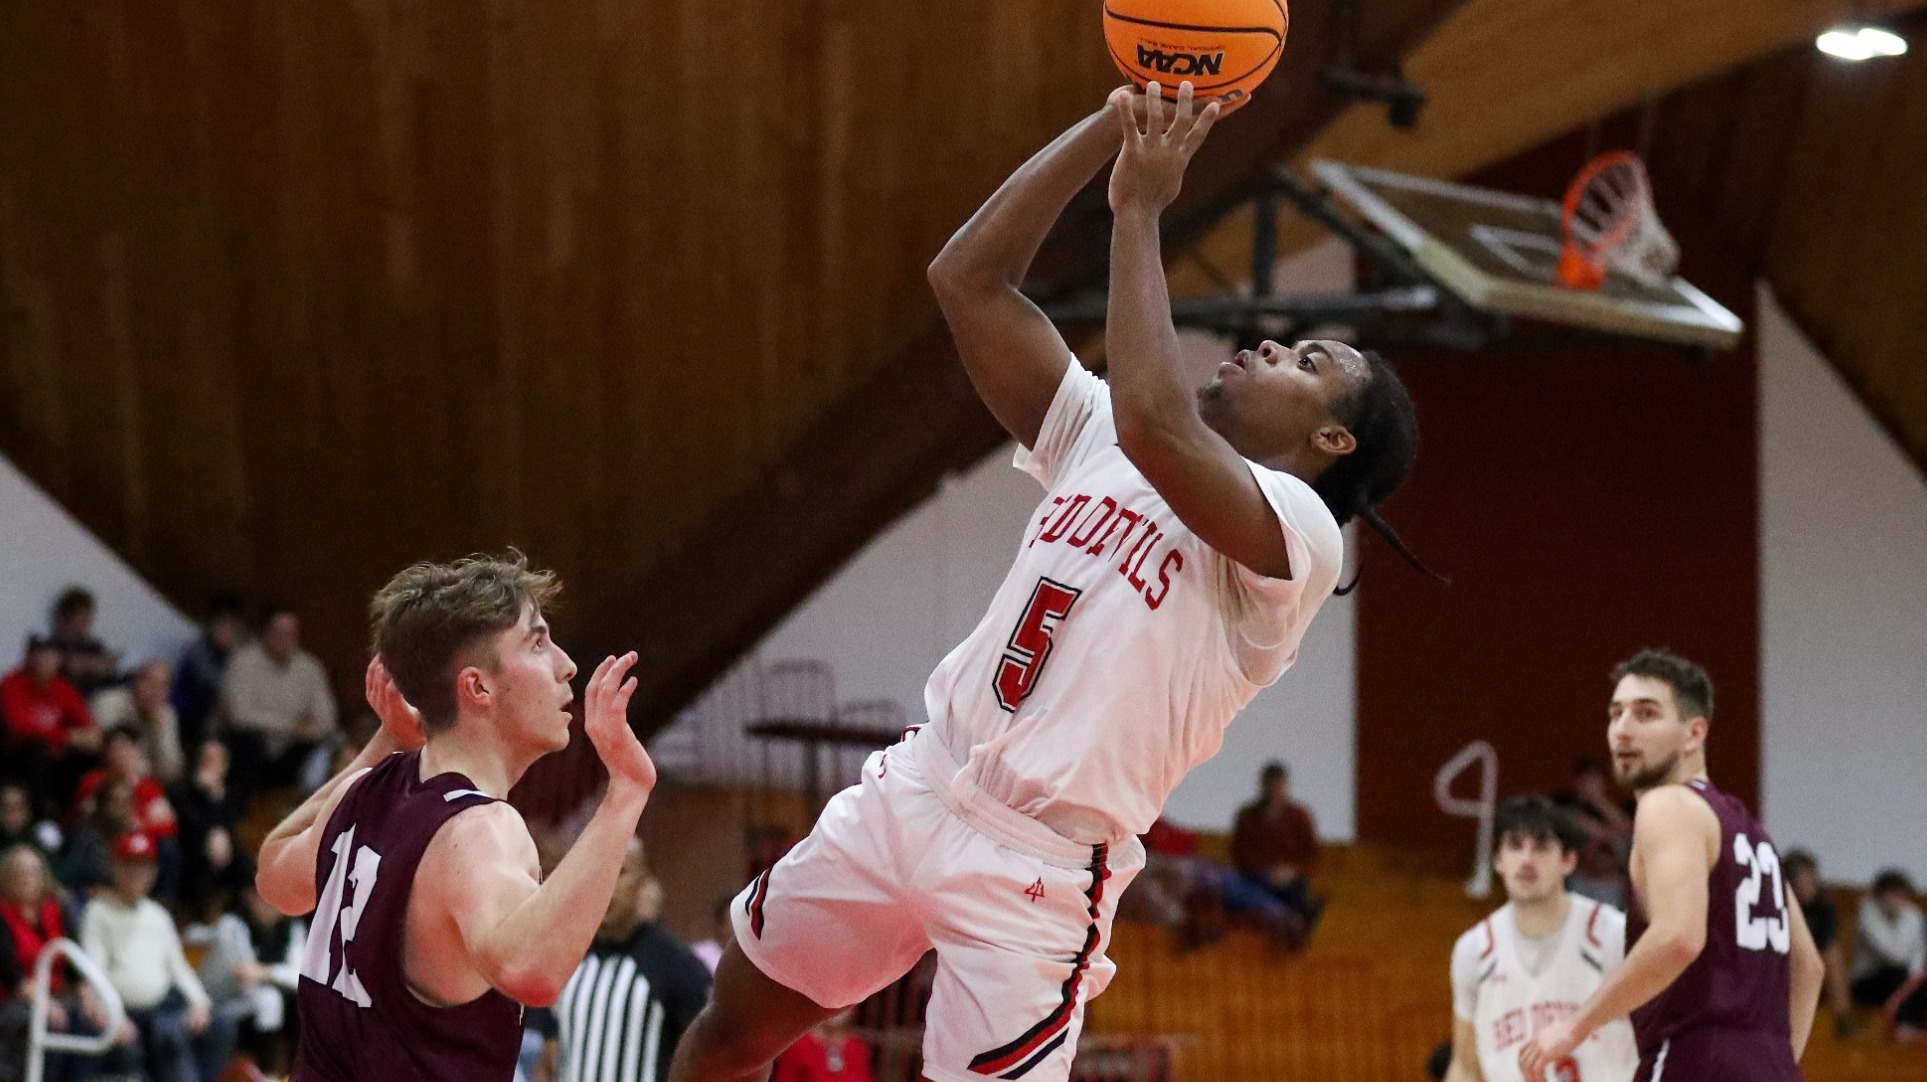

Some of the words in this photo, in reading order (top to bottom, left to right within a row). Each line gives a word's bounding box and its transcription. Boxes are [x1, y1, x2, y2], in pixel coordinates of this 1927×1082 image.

[1136, 43, 1223, 76] NCAA
[992, 576, 1082, 713] 5
[298, 823, 382, 1008] 12
[1734, 832, 1790, 954] 23
